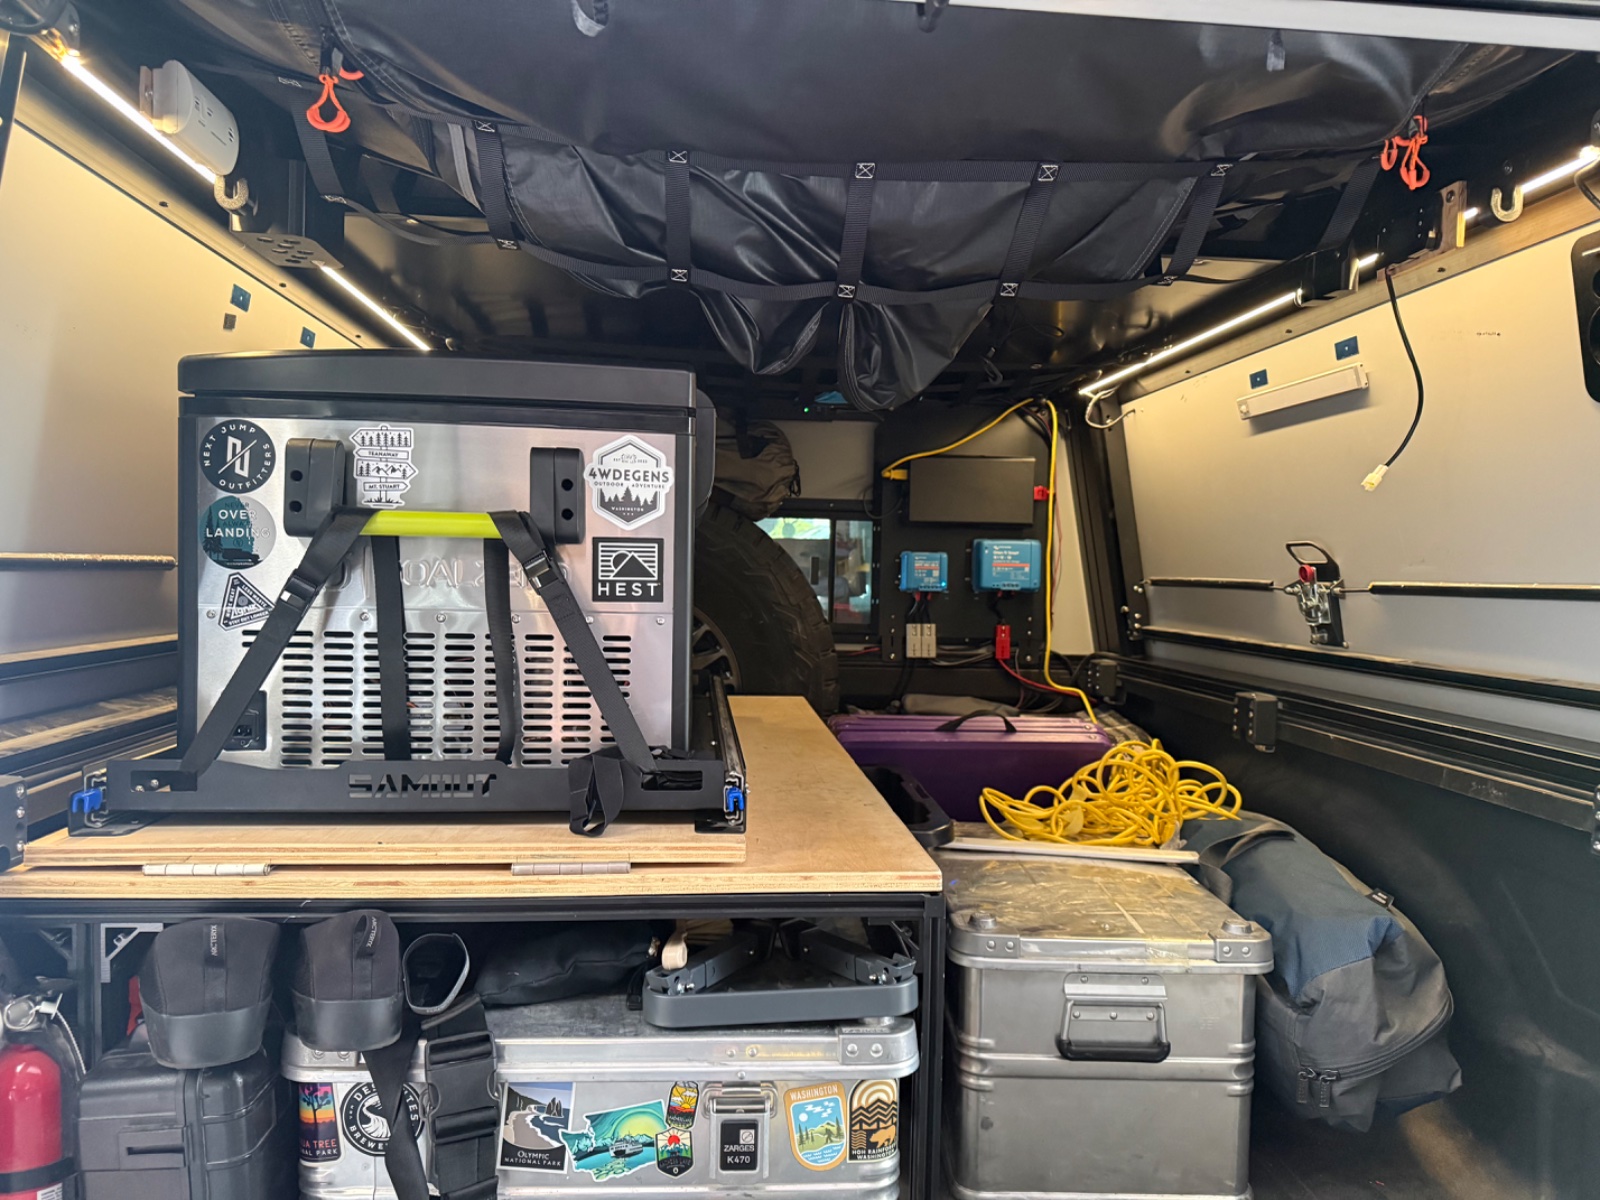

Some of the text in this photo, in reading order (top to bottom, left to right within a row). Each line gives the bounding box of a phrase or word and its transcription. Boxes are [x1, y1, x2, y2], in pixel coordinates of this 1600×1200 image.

[203, 424, 256, 467] NEXT JUMP
[219, 443, 272, 489] OUTFITTERS
[588, 467, 669, 483] 4WDEGENS
[218, 509, 257, 520] OVER
[205, 528, 271, 538] LANDING
[597, 582, 657, 597] HEST
[789, 1084, 839, 1101] WASHINGTON
[313, 1139, 337, 1149] TREE
[723, 1144, 755, 1152] ZARGES
[517, 1150, 550, 1160] OLYMPIC
[727, 1155, 751, 1164] K470
[504, 1157, 541, 1165] NATIONAL
